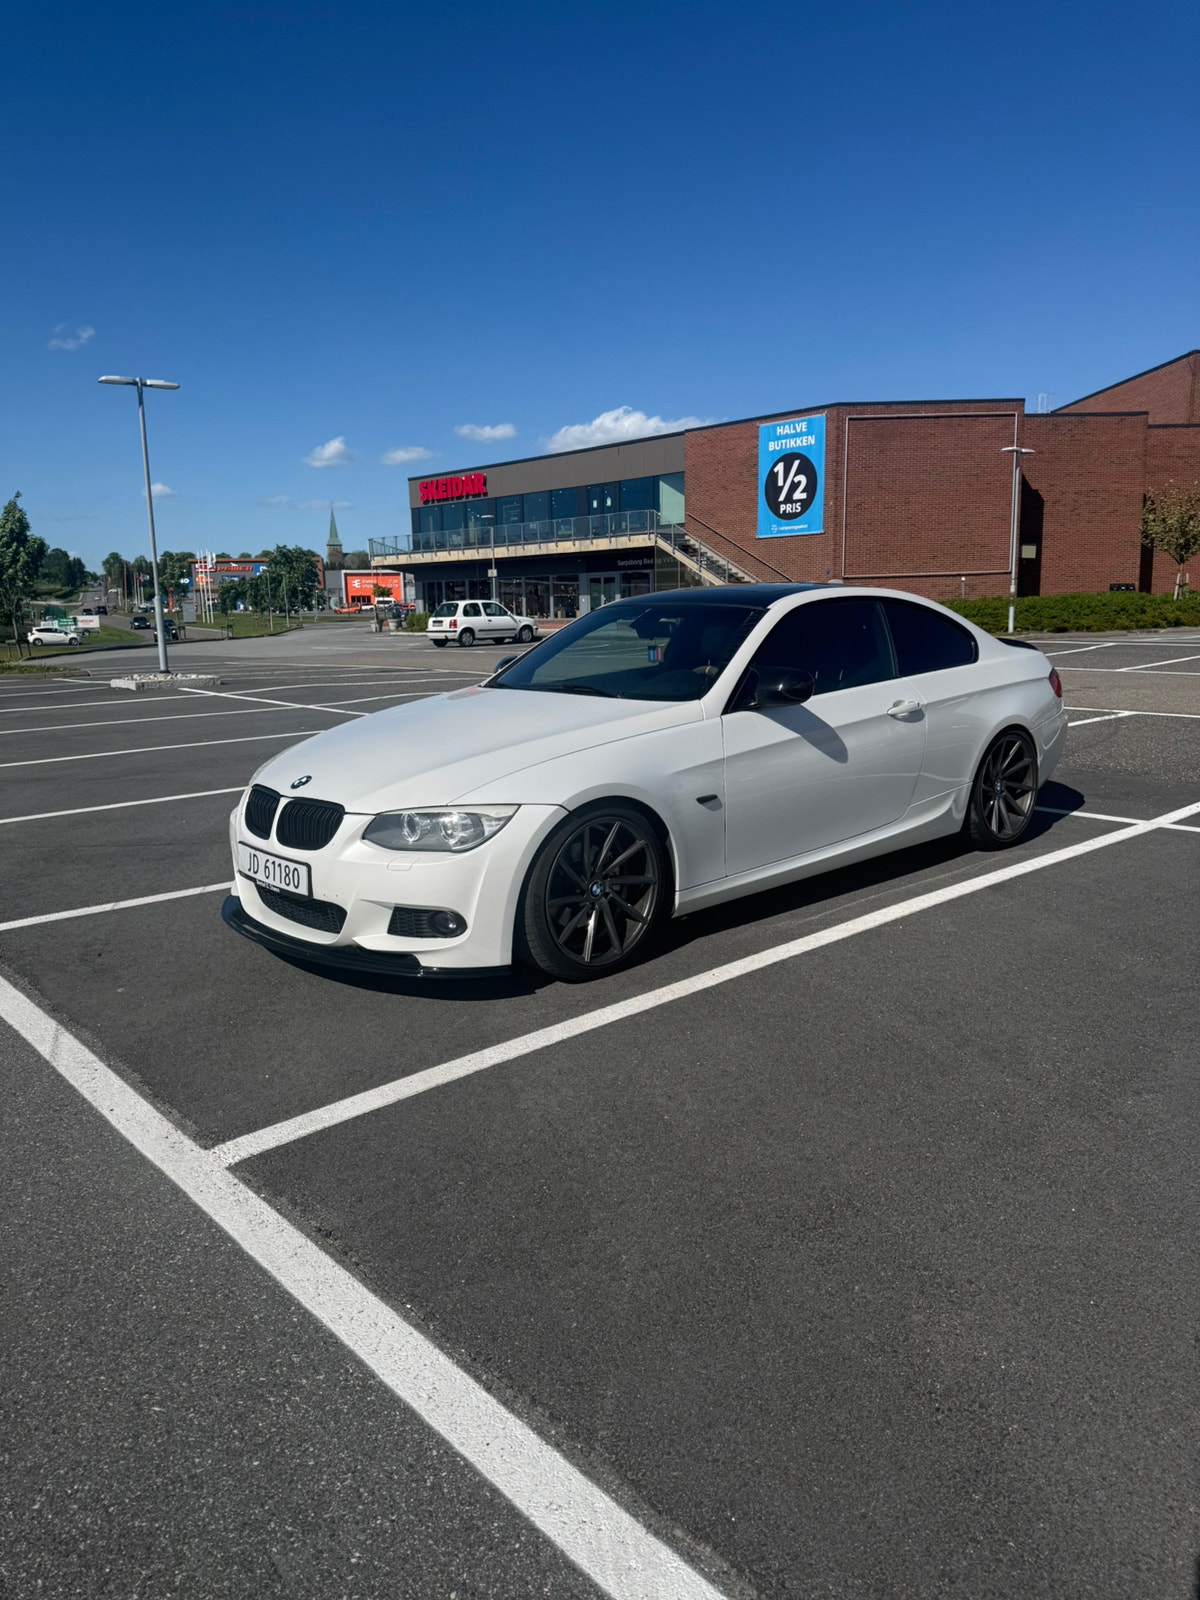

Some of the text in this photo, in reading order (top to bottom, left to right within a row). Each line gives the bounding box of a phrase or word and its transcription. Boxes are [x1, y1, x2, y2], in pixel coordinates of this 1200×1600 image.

[776, 421, 807, 436] HALVE
[769, 435, 815, 451] BUTIKKEN
[418, 473, 486, 502] SKEIDAR
[773, 459, 807, 502] 1/2
[779, 503, 801, 514] PRIS
[248, 852, 259, 874] JD
[264, 859, 300, 889] 61180
